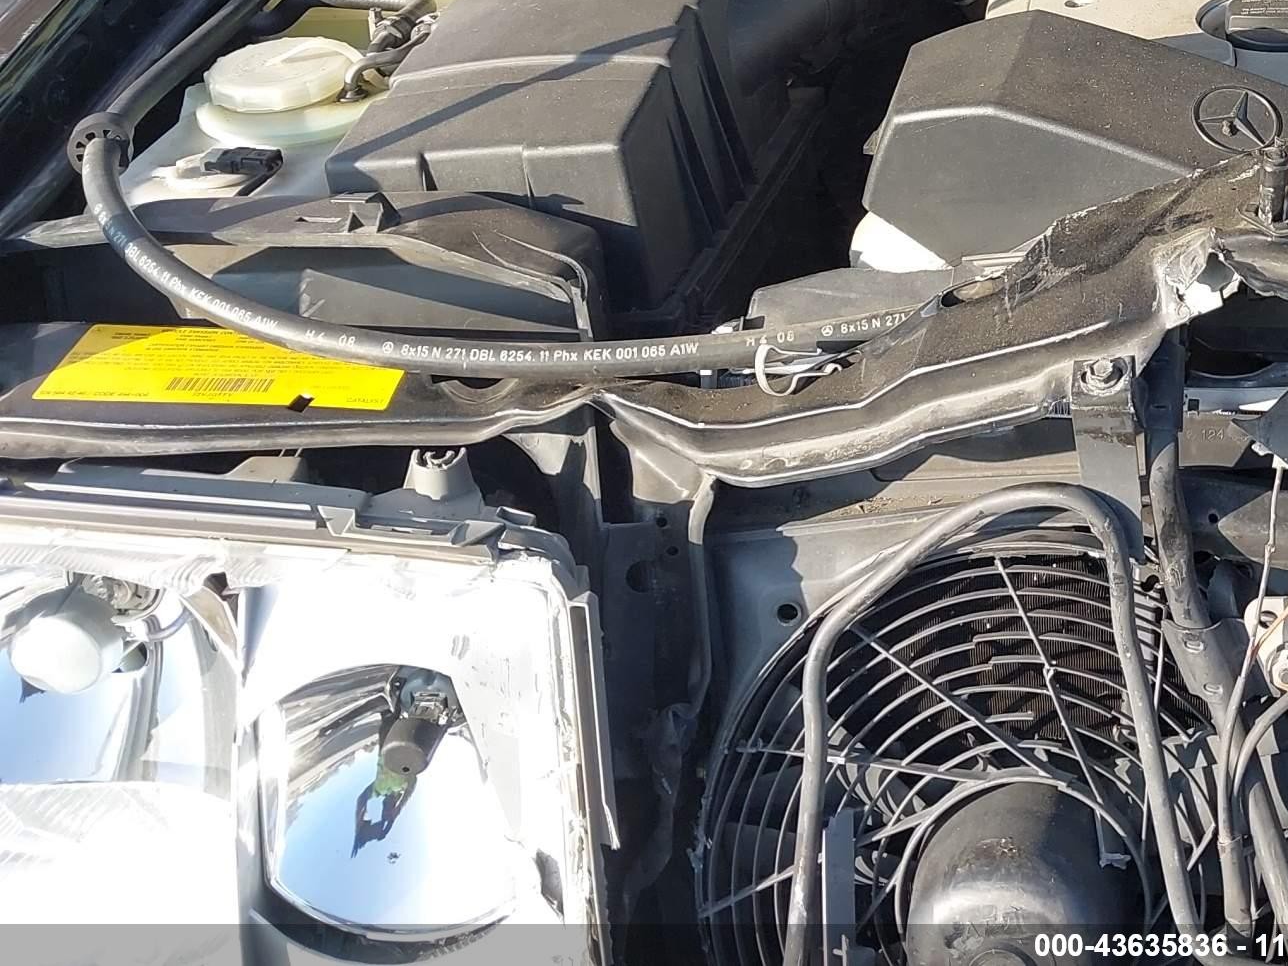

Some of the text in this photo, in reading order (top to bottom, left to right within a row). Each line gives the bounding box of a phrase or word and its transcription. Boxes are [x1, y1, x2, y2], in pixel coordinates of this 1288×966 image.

[840, 314, 906, 334] 8x15 N 271
[338, 333, 356, 348] 08
[776, 330, 795, 343] 08
[400, 343, 430, 358] 8x15
[431, 346, 442, 359] N
[445, 347, 466, 361] 271
[469, 348, 496, 362] DBL
[553, 348, 578, 363] Phx
[583, 347, 612, 361] KEK
[615, 346, 638, 361] 001
[669, 341, 700, 357] A1W
